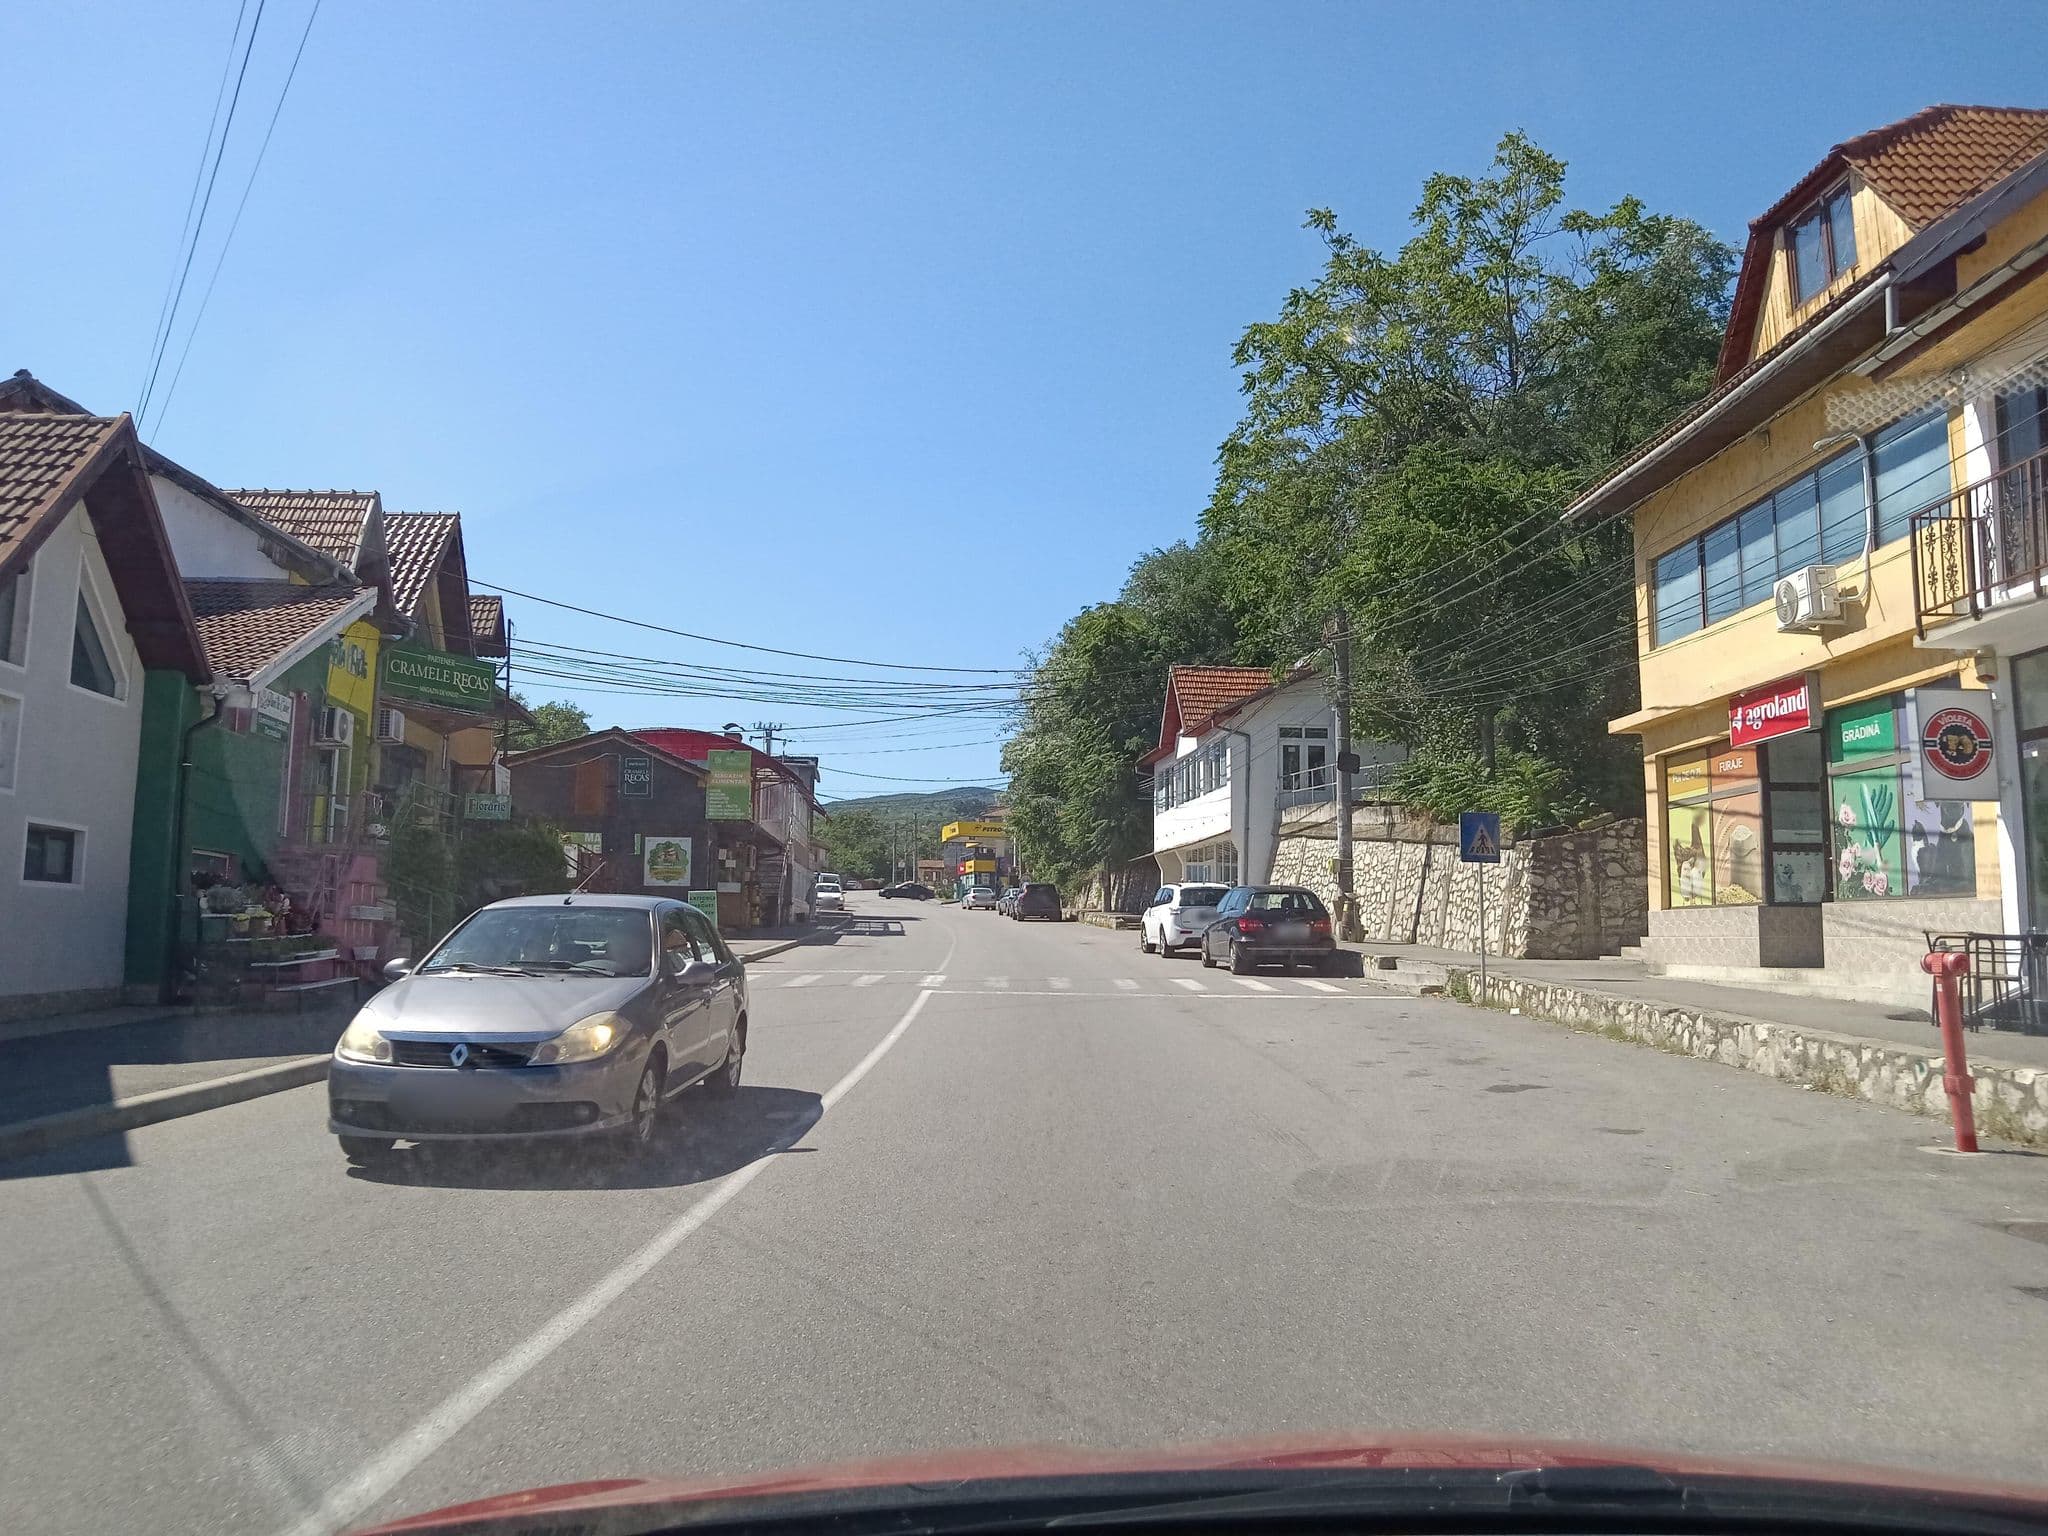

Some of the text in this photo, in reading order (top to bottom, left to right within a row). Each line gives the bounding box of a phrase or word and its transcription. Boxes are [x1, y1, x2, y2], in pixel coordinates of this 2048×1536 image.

[427, 654, 456, 667] PARTENER
[390, 659, 450, 683] CRAMELE
[453, 671, 490, 694] RECAS
[1745, 687, 1806, 730] agroland
[1937, 713, 1973, 727] VIOLETA
[1719, 757, 1743, 773] FURAJE
[624, 774, 650, 785] RECAS
